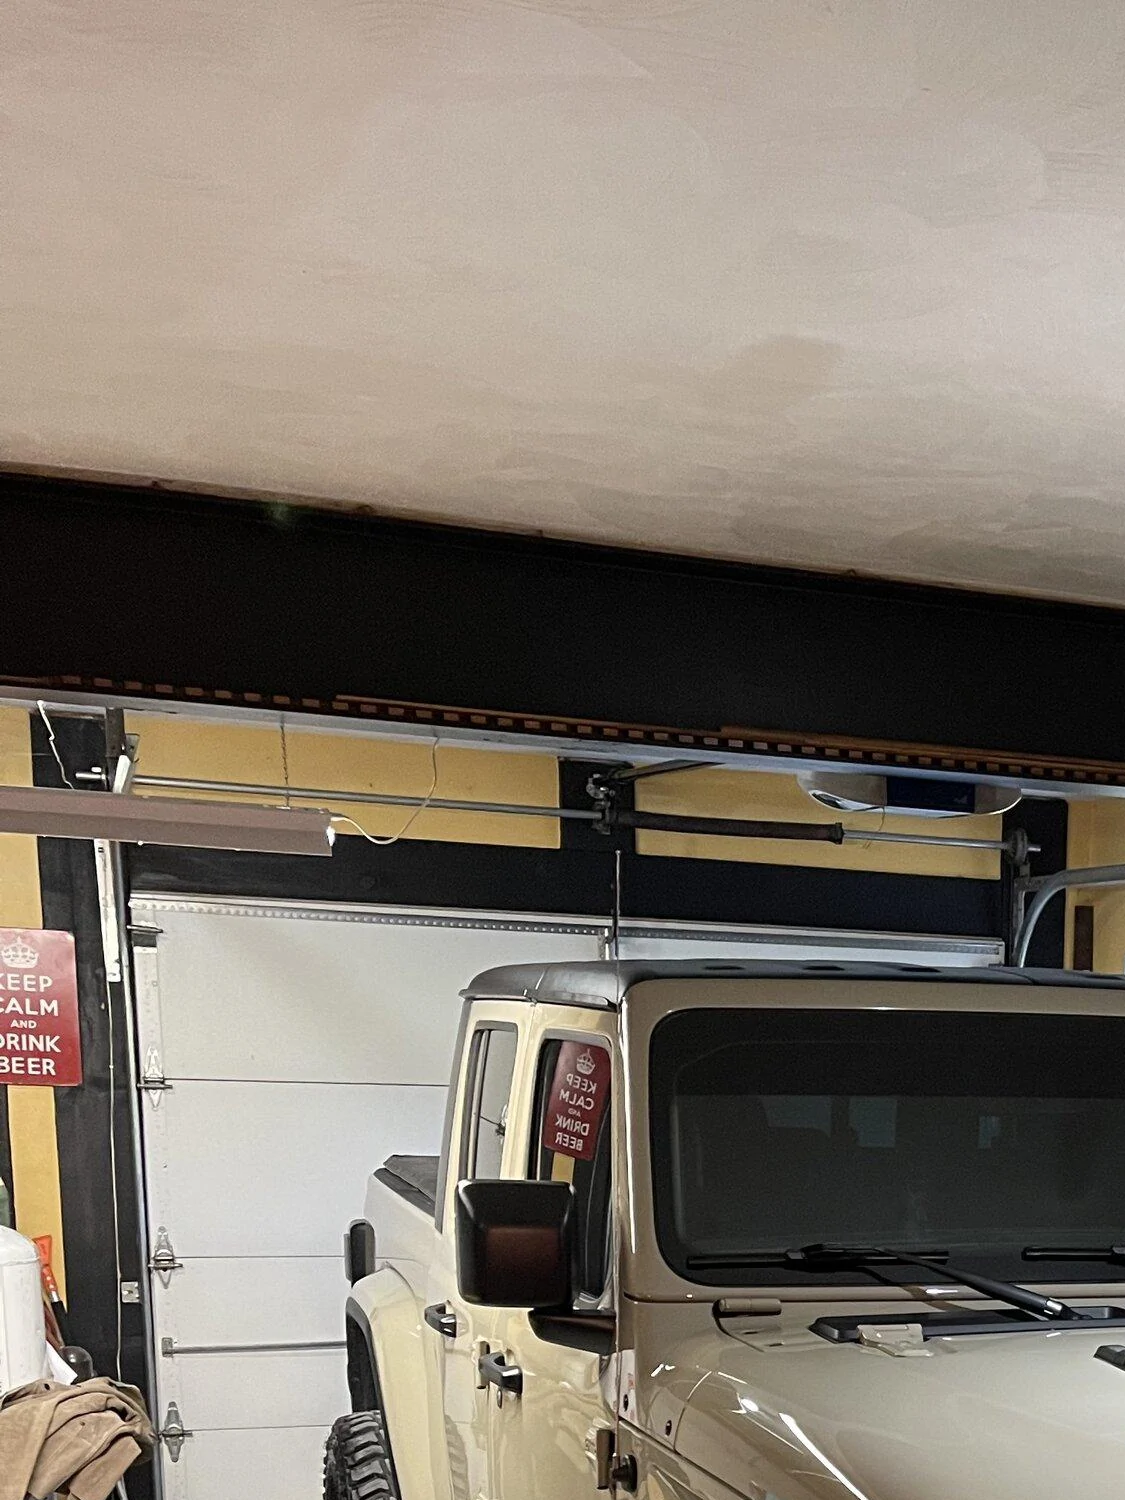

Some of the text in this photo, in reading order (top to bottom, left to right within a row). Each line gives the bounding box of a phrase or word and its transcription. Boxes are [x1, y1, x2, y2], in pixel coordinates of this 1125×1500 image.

[0, 996, 59, 1017] ALM
[10, 1019, 37, 1029] AND
[0, 1056, 56, 1076] BEER
